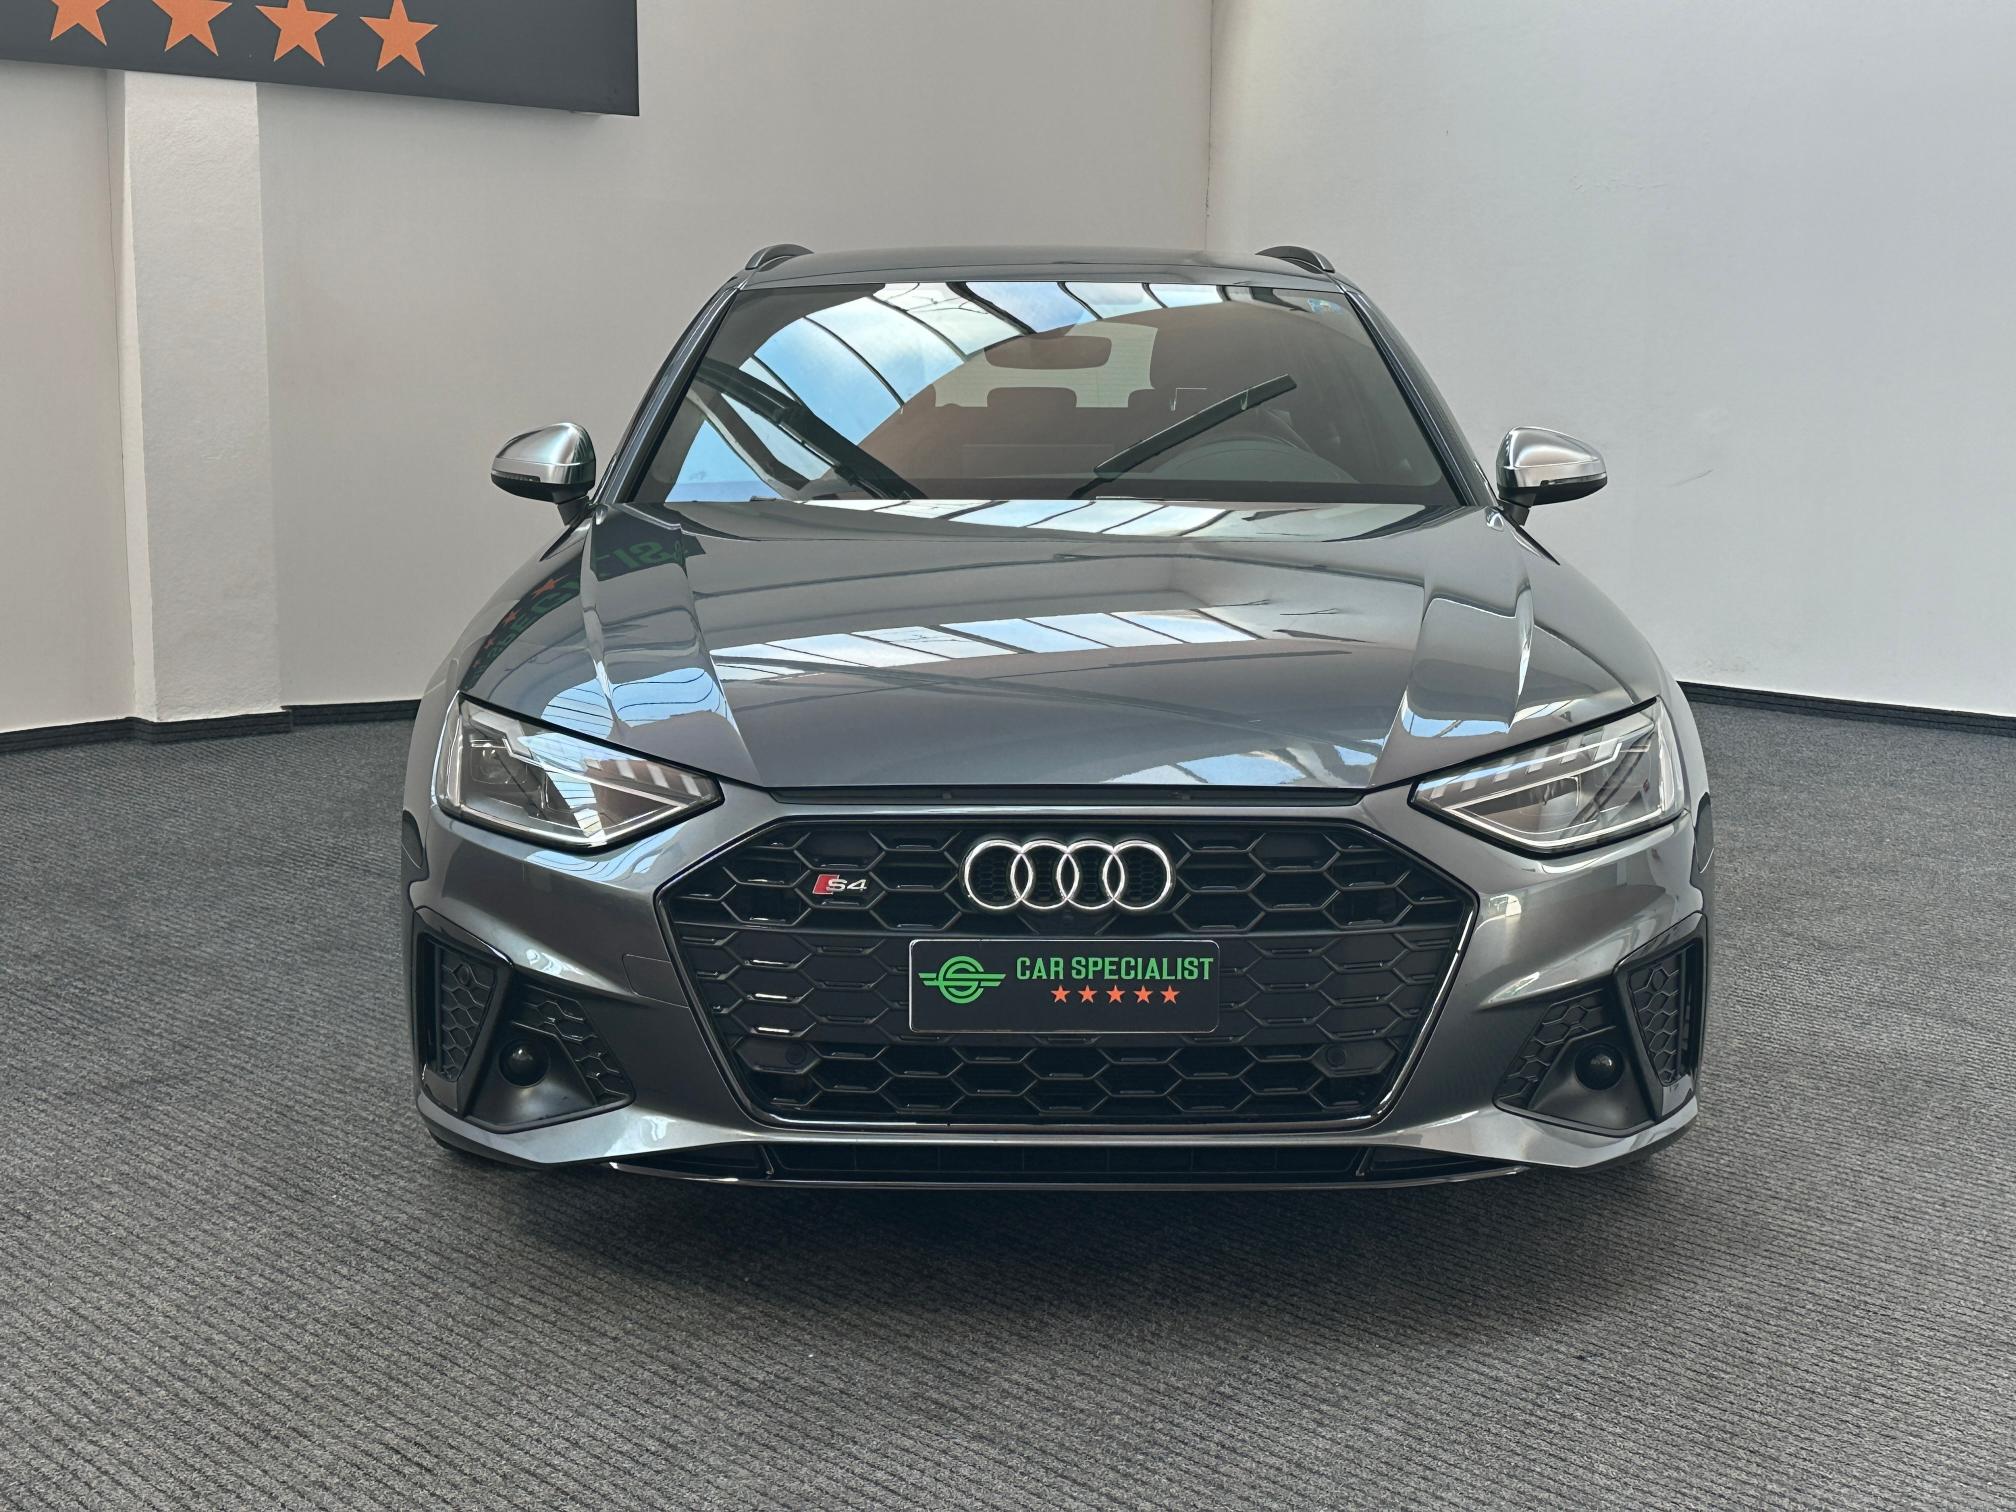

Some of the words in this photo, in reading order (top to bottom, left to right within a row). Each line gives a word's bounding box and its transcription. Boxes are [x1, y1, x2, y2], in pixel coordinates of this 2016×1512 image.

[825, 877, 868, 893] S4
[1016, 957, 1064, 980] CAR
[1071, 957, 1214, 980] SPECIALIST
